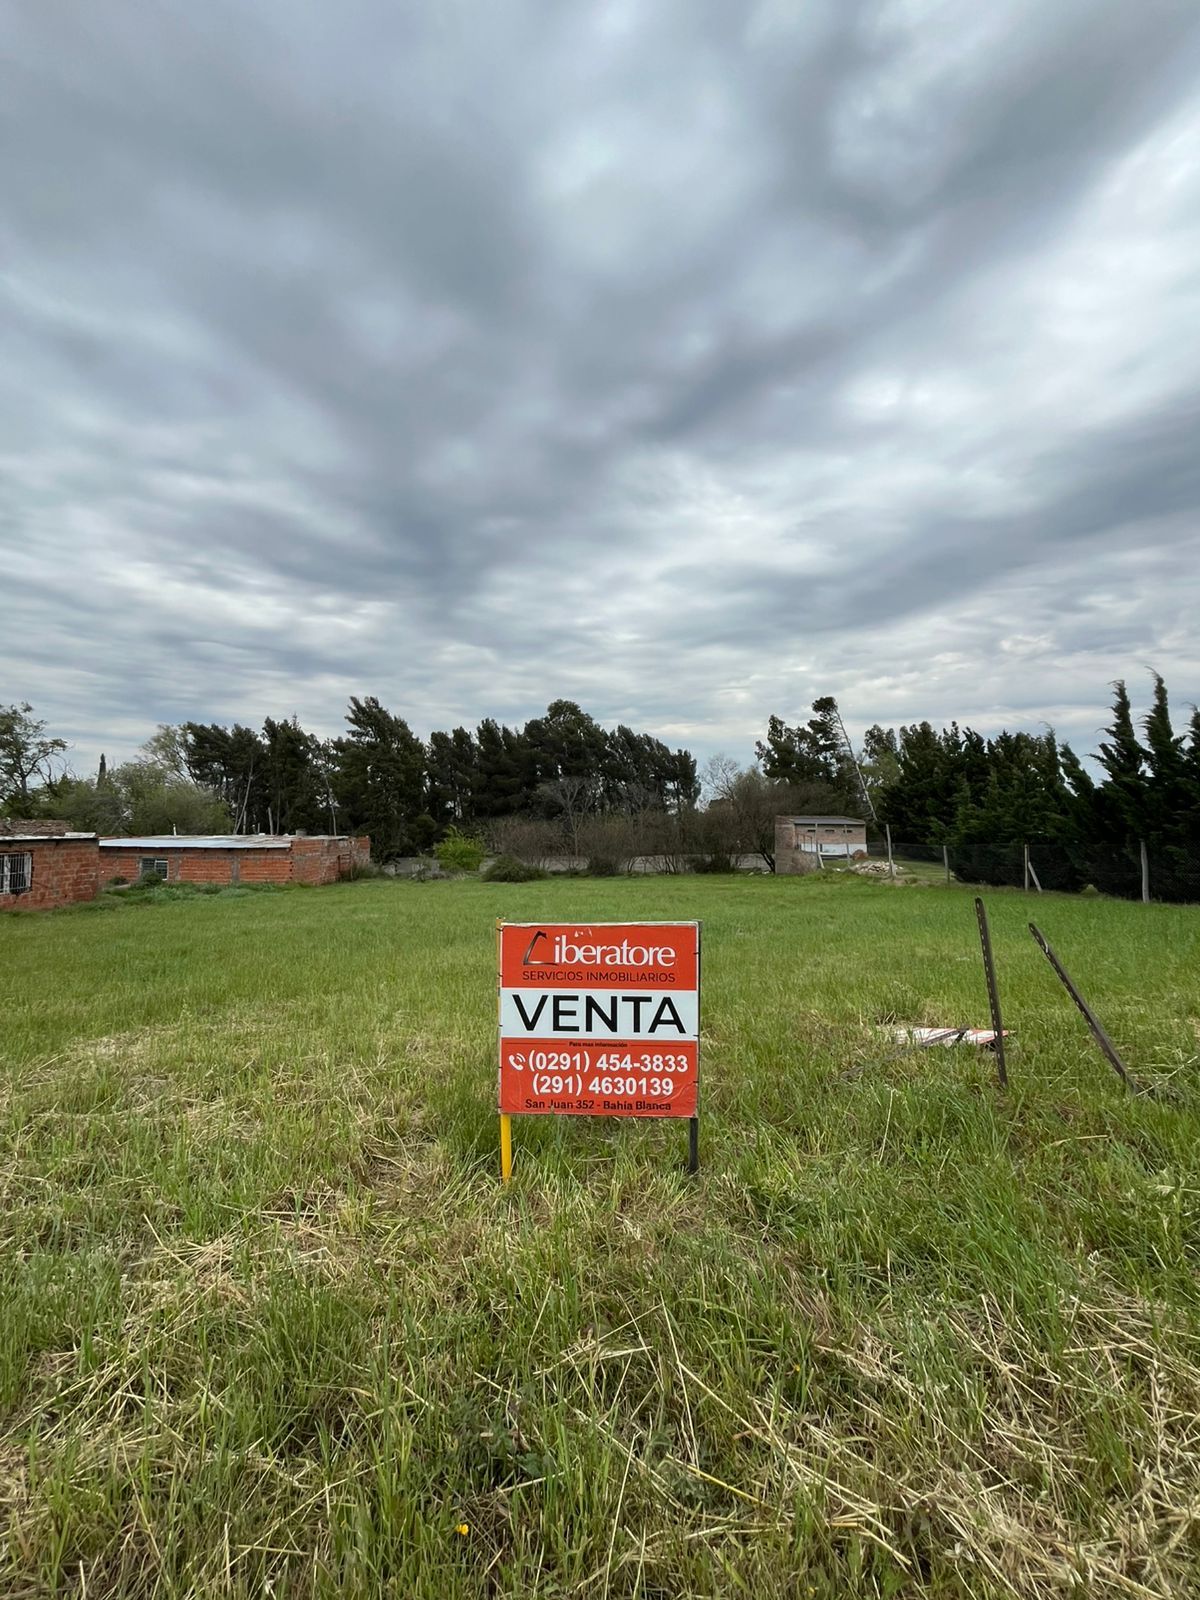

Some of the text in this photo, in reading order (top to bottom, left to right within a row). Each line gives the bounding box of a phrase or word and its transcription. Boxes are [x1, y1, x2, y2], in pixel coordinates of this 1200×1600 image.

[523, 930, 676, 967] Liberatore
[522, 970, 676, 983] SERVICIOS INMOBILIARIOS
[512, 994, 686, 1034] VENTA
[528, 1050, 689, 1073] (0291) 454-3833
[532, 1073, 674, 1097] (291) 4630139
[525, 1099, 545, 1109] San
[548, 1099, 573, 1109] Juan
[575, 1100, 595, 1110] 352
[635, 1102, 671, 1111] Blanca
